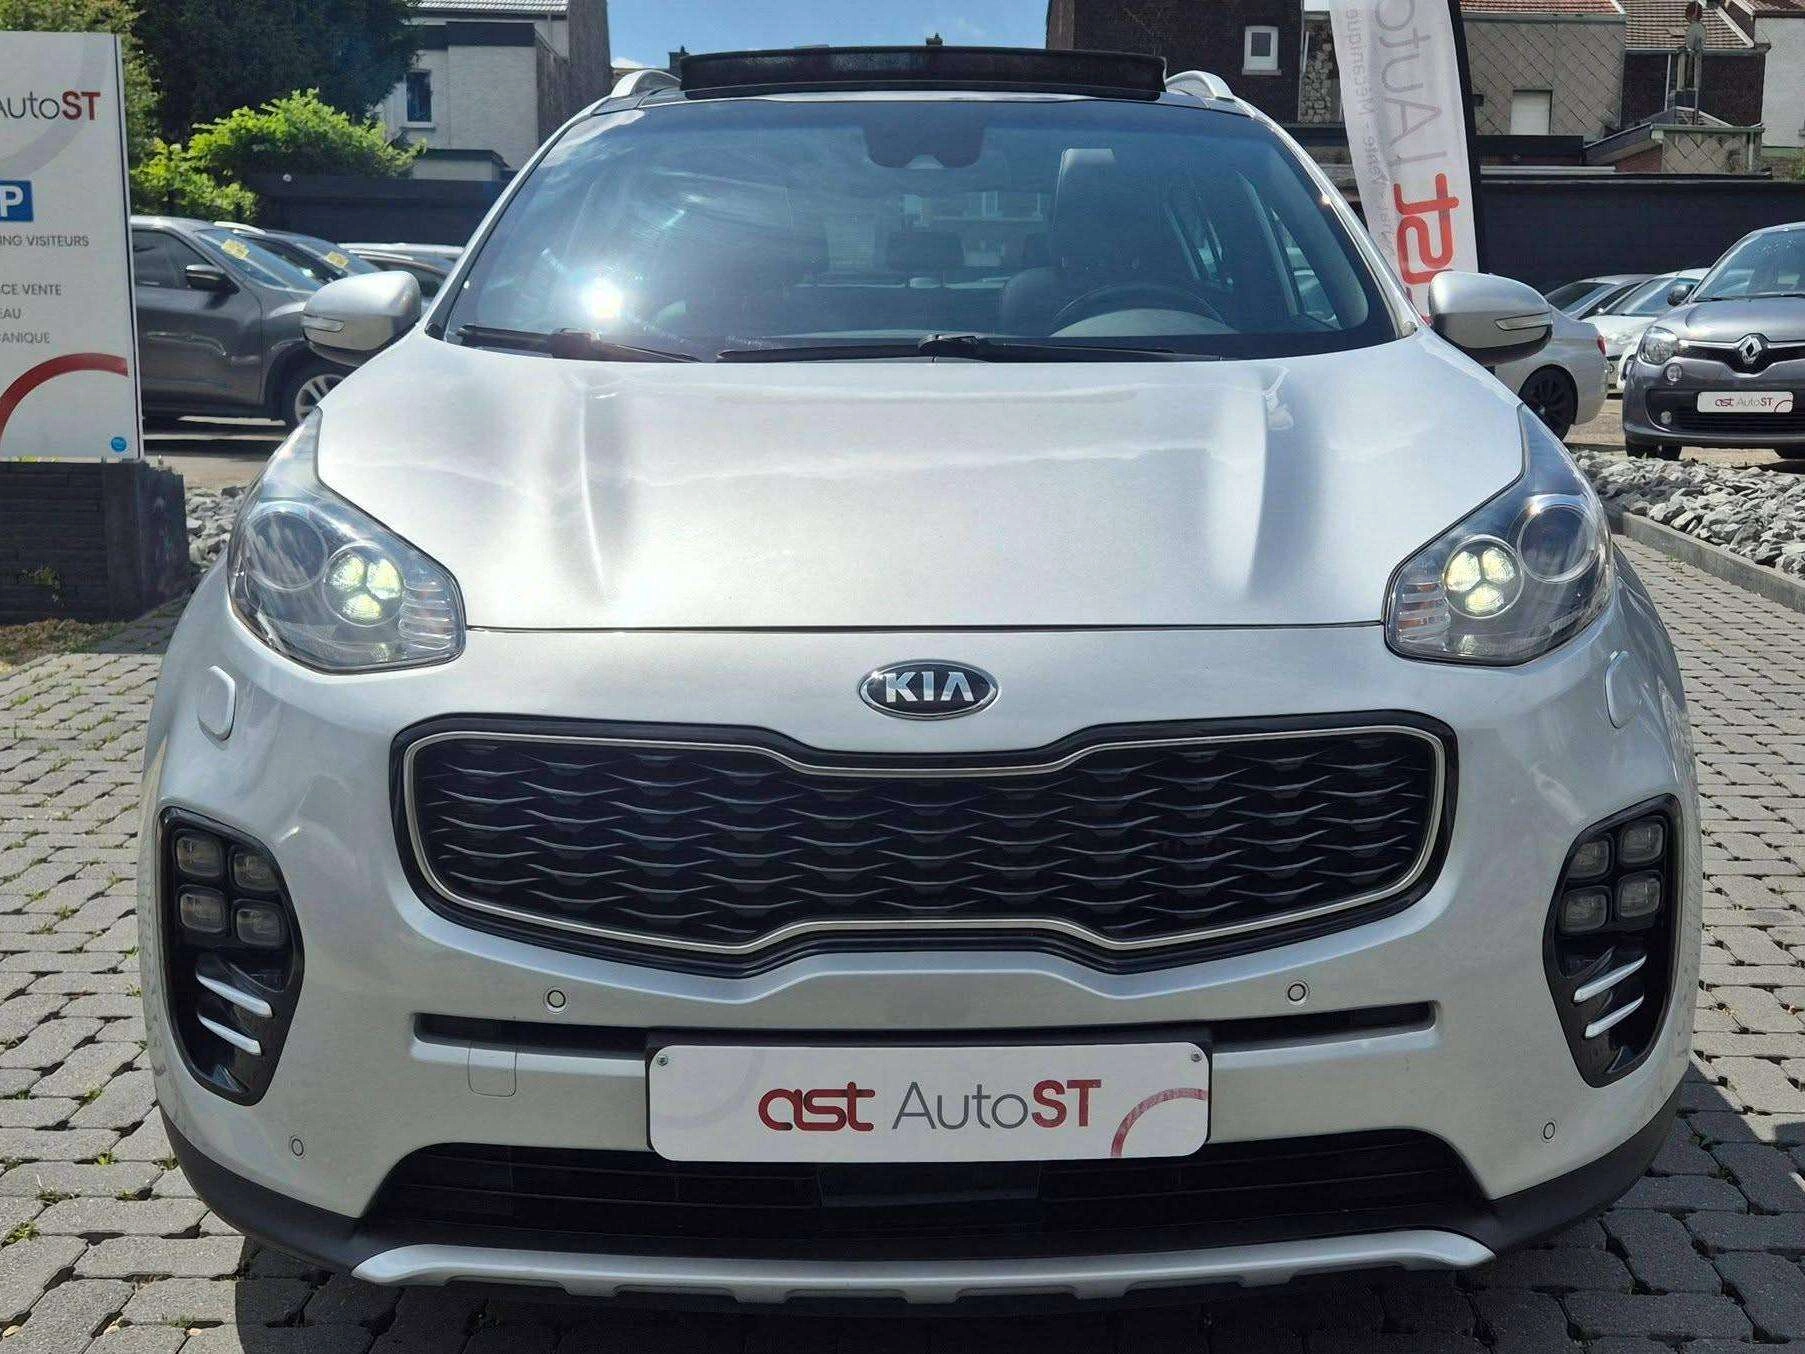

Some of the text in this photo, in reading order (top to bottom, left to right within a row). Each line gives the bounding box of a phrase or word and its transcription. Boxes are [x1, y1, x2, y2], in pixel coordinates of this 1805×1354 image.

[0, 185, 24, 217] P
[25, 234, 90, 248] VISITEURS
[22, 284, 62, 297] VENTE
[1737, 397, 1773, 407] AutoST
[885, 671, 975, 703] KIA
[758, 1079, 1102, 1132] ast AutoST
